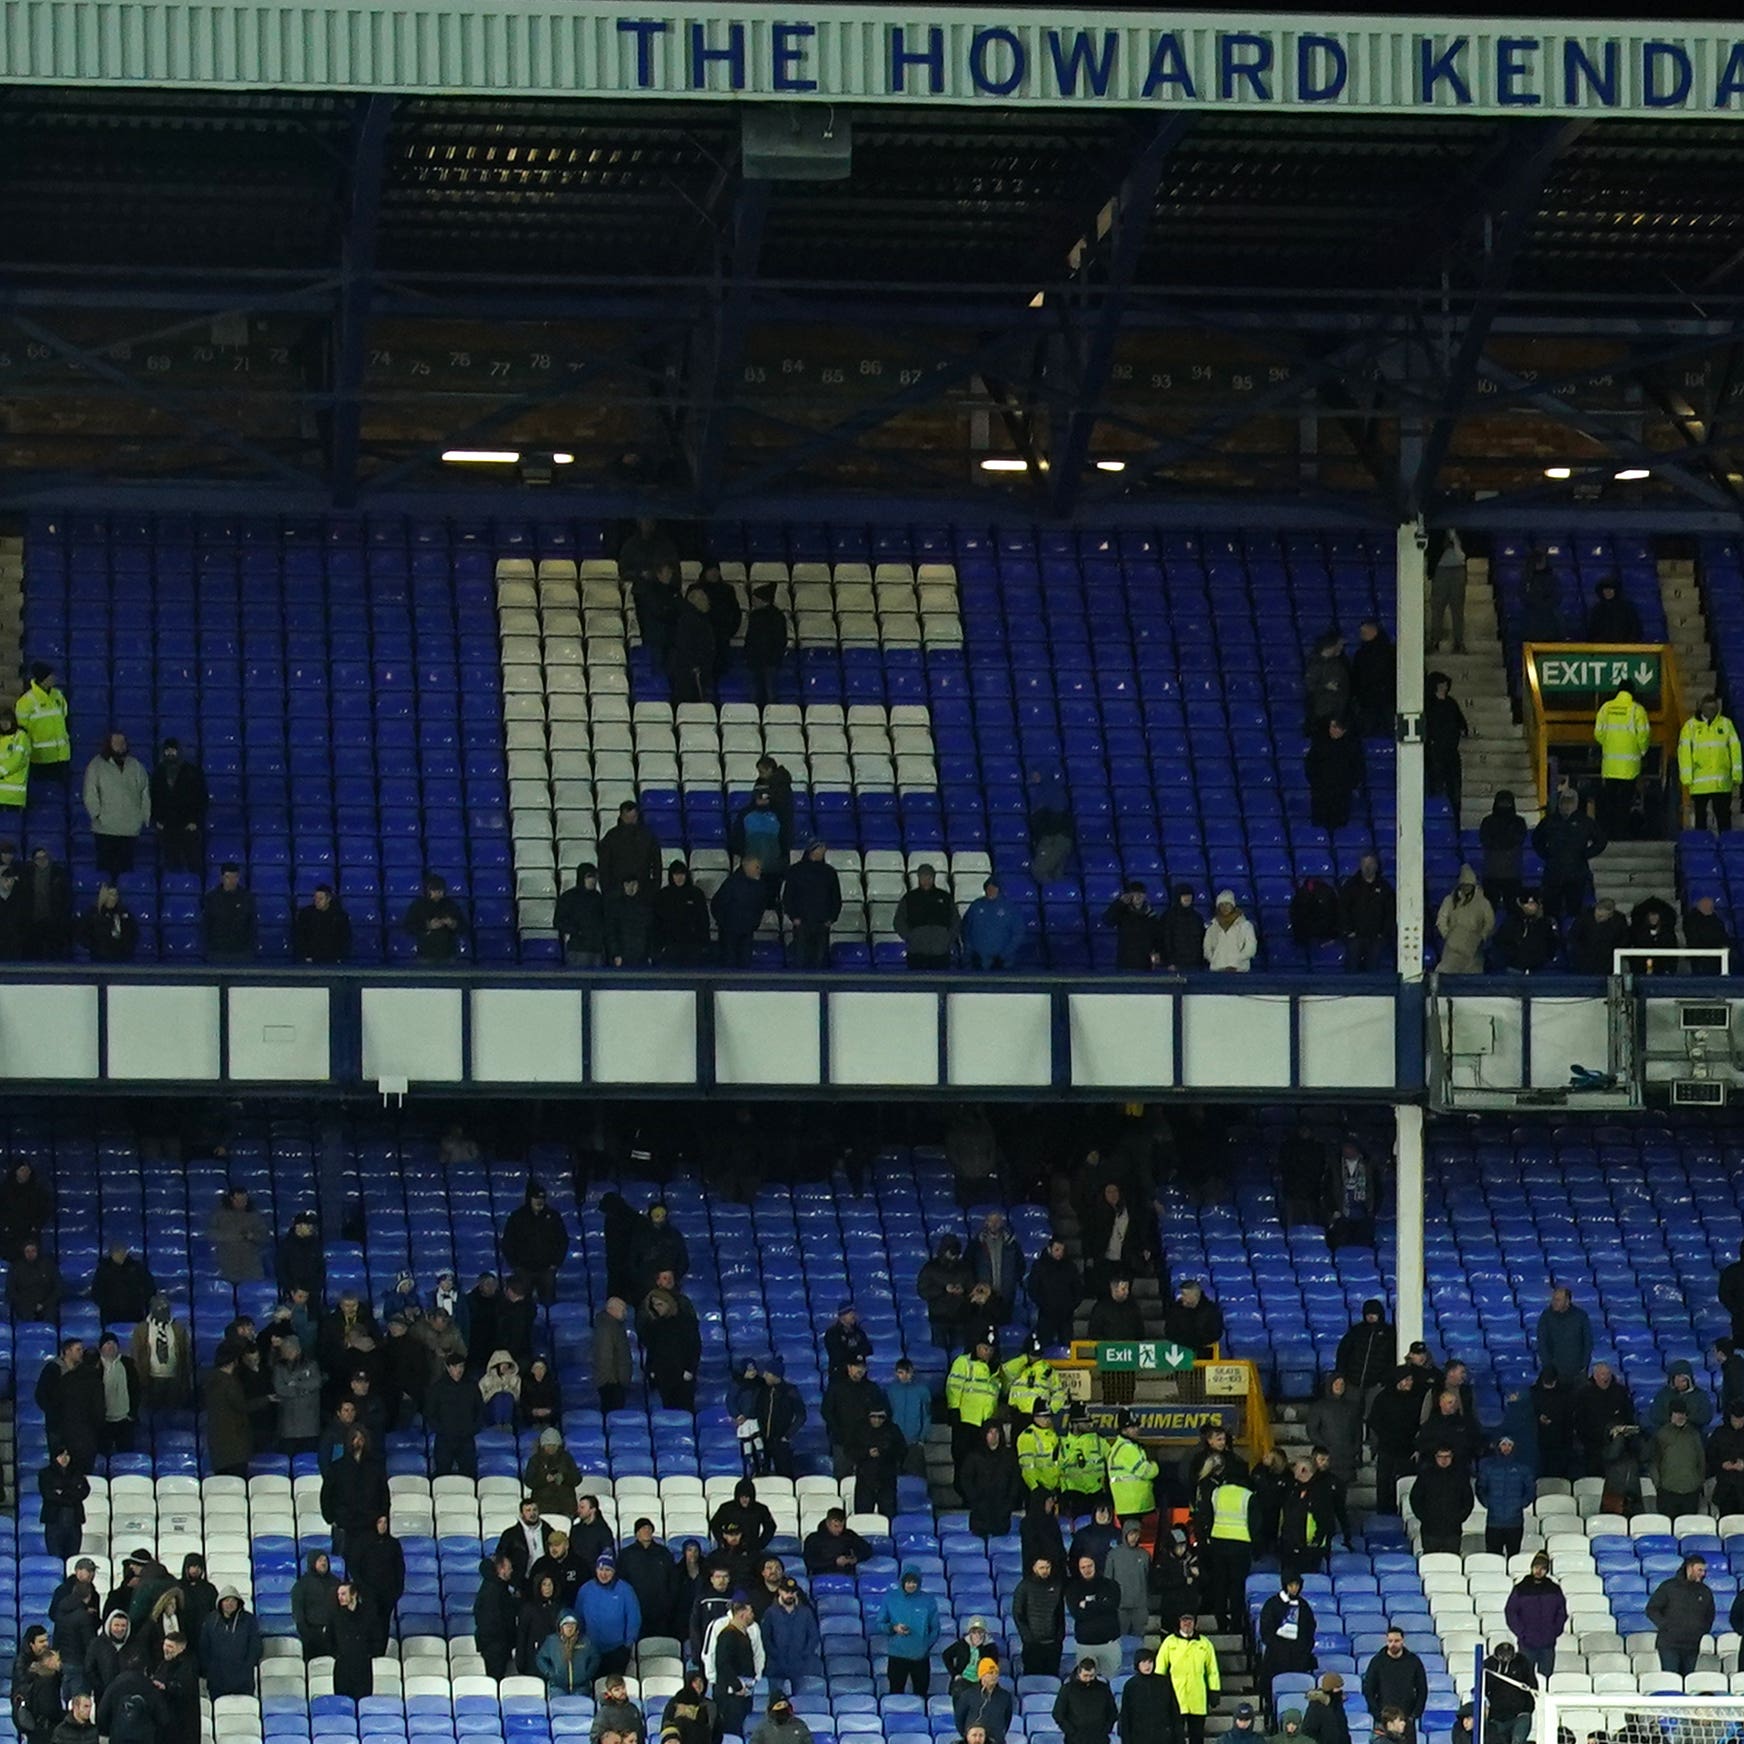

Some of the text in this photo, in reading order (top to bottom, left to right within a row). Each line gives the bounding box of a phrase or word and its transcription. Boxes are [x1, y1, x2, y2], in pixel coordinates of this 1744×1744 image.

[617, 20, 819, 91] THE
[883, 25, 1350, 103] HOWARD
[269, 348, 289, 364] 72
[370, 350, 393, 366] 74
[448, 351, 471, 368] 76
[530, 353, 551, 369] 78
[233, 357, 249, 373] 71
[410, 359, 432, 376] 75
[489, 361, 511, 377] 77
[1191, 364, 1213, 381] 94
[899, 369, 922, 385] 87
[1151, 373, 1172, 390] 93
[1231, 374, 1253, 391] 95
[1542, 661, 1608, 686] EXIT
[1106, 1349, 1133, 1362] Exit
